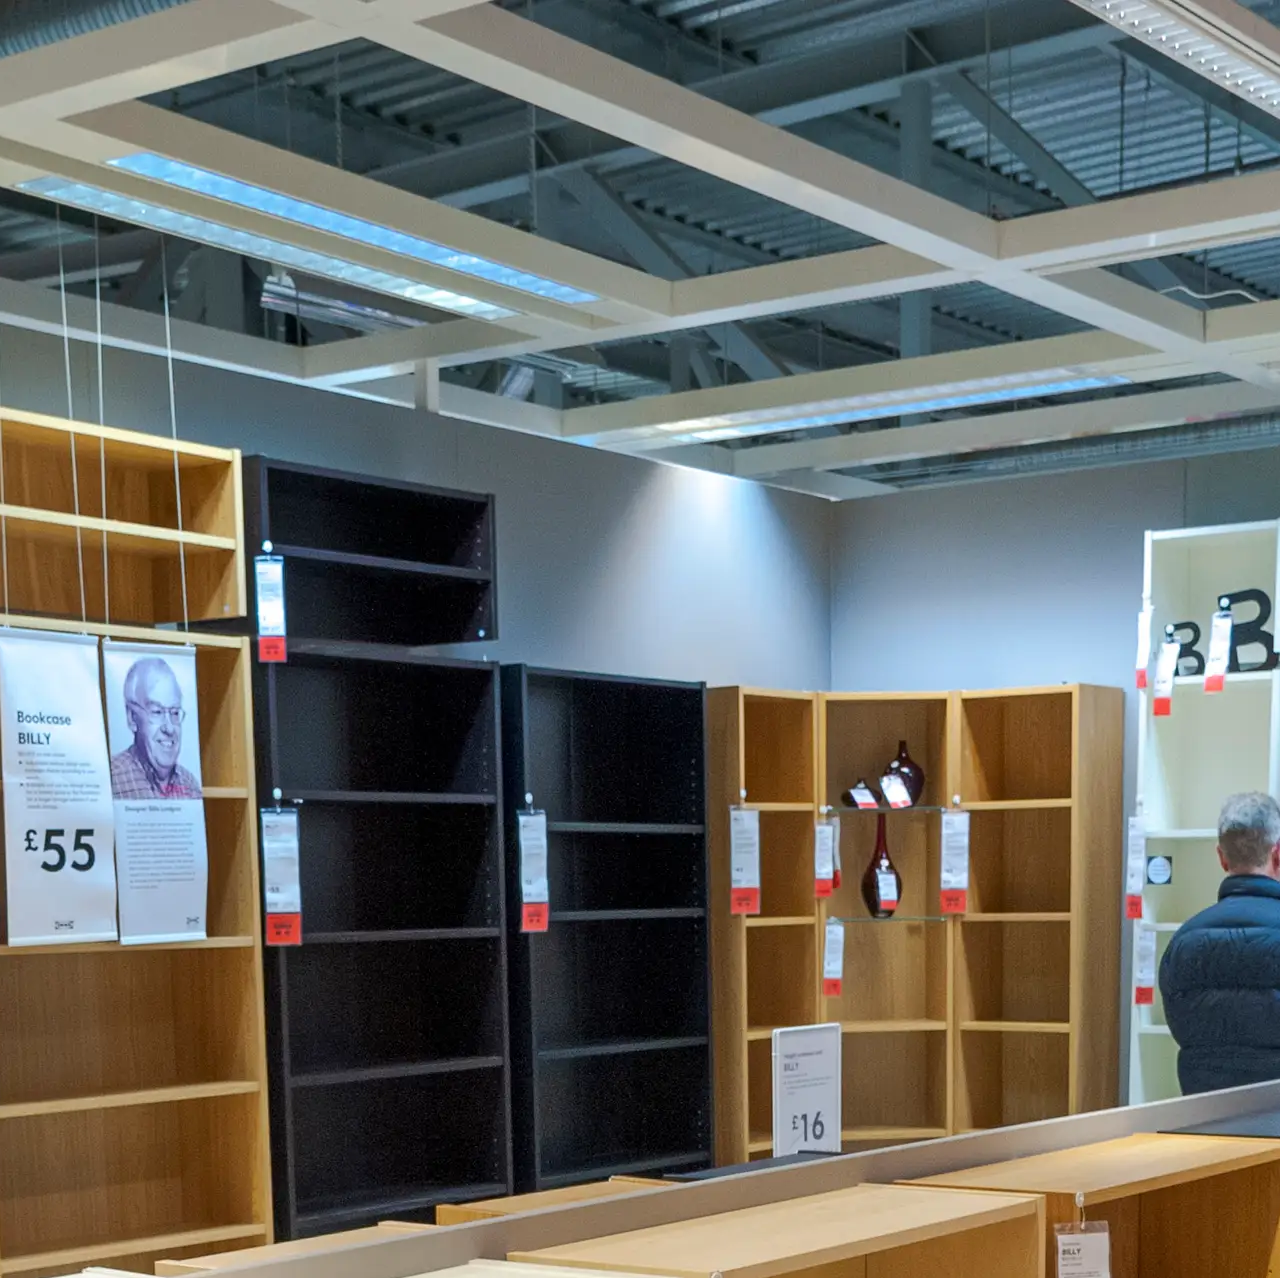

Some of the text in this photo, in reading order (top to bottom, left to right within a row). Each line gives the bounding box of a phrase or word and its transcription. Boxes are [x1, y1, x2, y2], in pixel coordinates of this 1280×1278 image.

[17, 710, 72, 726] Bookcase
[18, 731, 52, 745] BILLY
[24, 829, 96, 872] £55
[792, 1111, 825, 1142] £16
